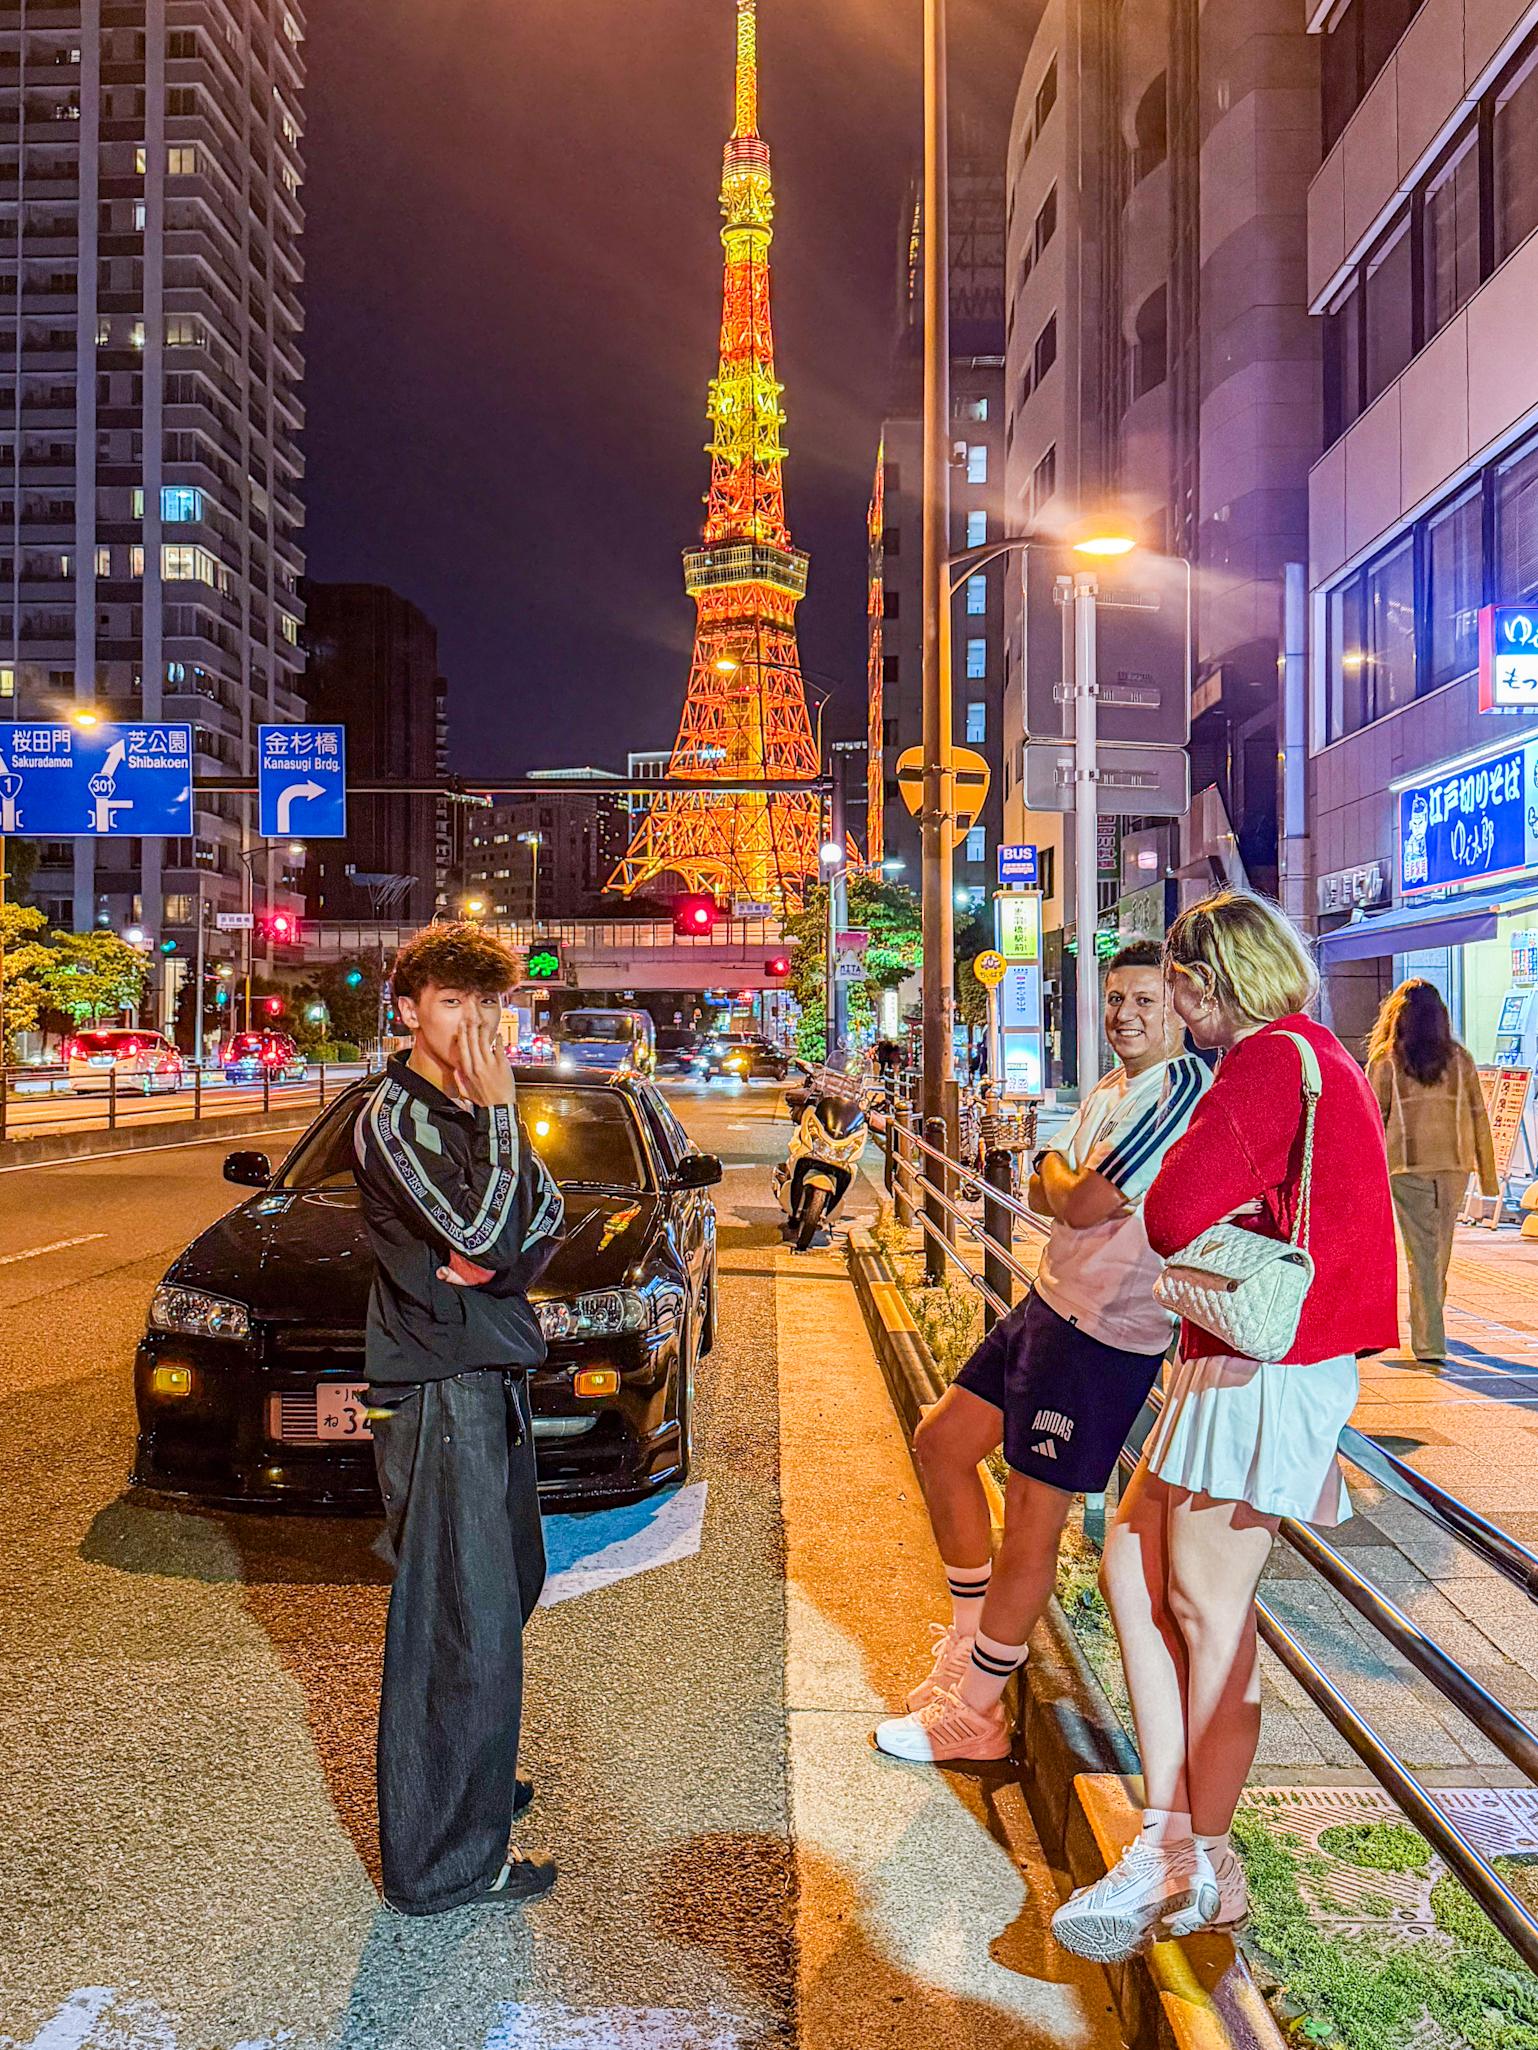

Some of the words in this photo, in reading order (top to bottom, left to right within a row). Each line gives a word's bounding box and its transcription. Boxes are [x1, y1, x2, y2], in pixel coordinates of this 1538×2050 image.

[12, 730, 71, 753] 桜田門
[128, 730, 187, 753] 芝公園
[265, 731, 338, 755] 金杉橋
[12, 755, 73, 768] Sakuradamon
[128, 755, 188, 769] Shibakoen
[263, 756, 311, 772] Kanasugi
[314, 757, 341, 772] Brdg.
[4, 778, 12, 793] 1
[92, 779, 112, 793] 301
[1429, 755, 1521, 827] 江戸切りそば
[1003, 847, 1033, 860] BUS
[840, 964, 861, 972] MITA
[323, 1413, 339, 1428] ね
[1031, 1409, 1074, 1442] ADIDAS
